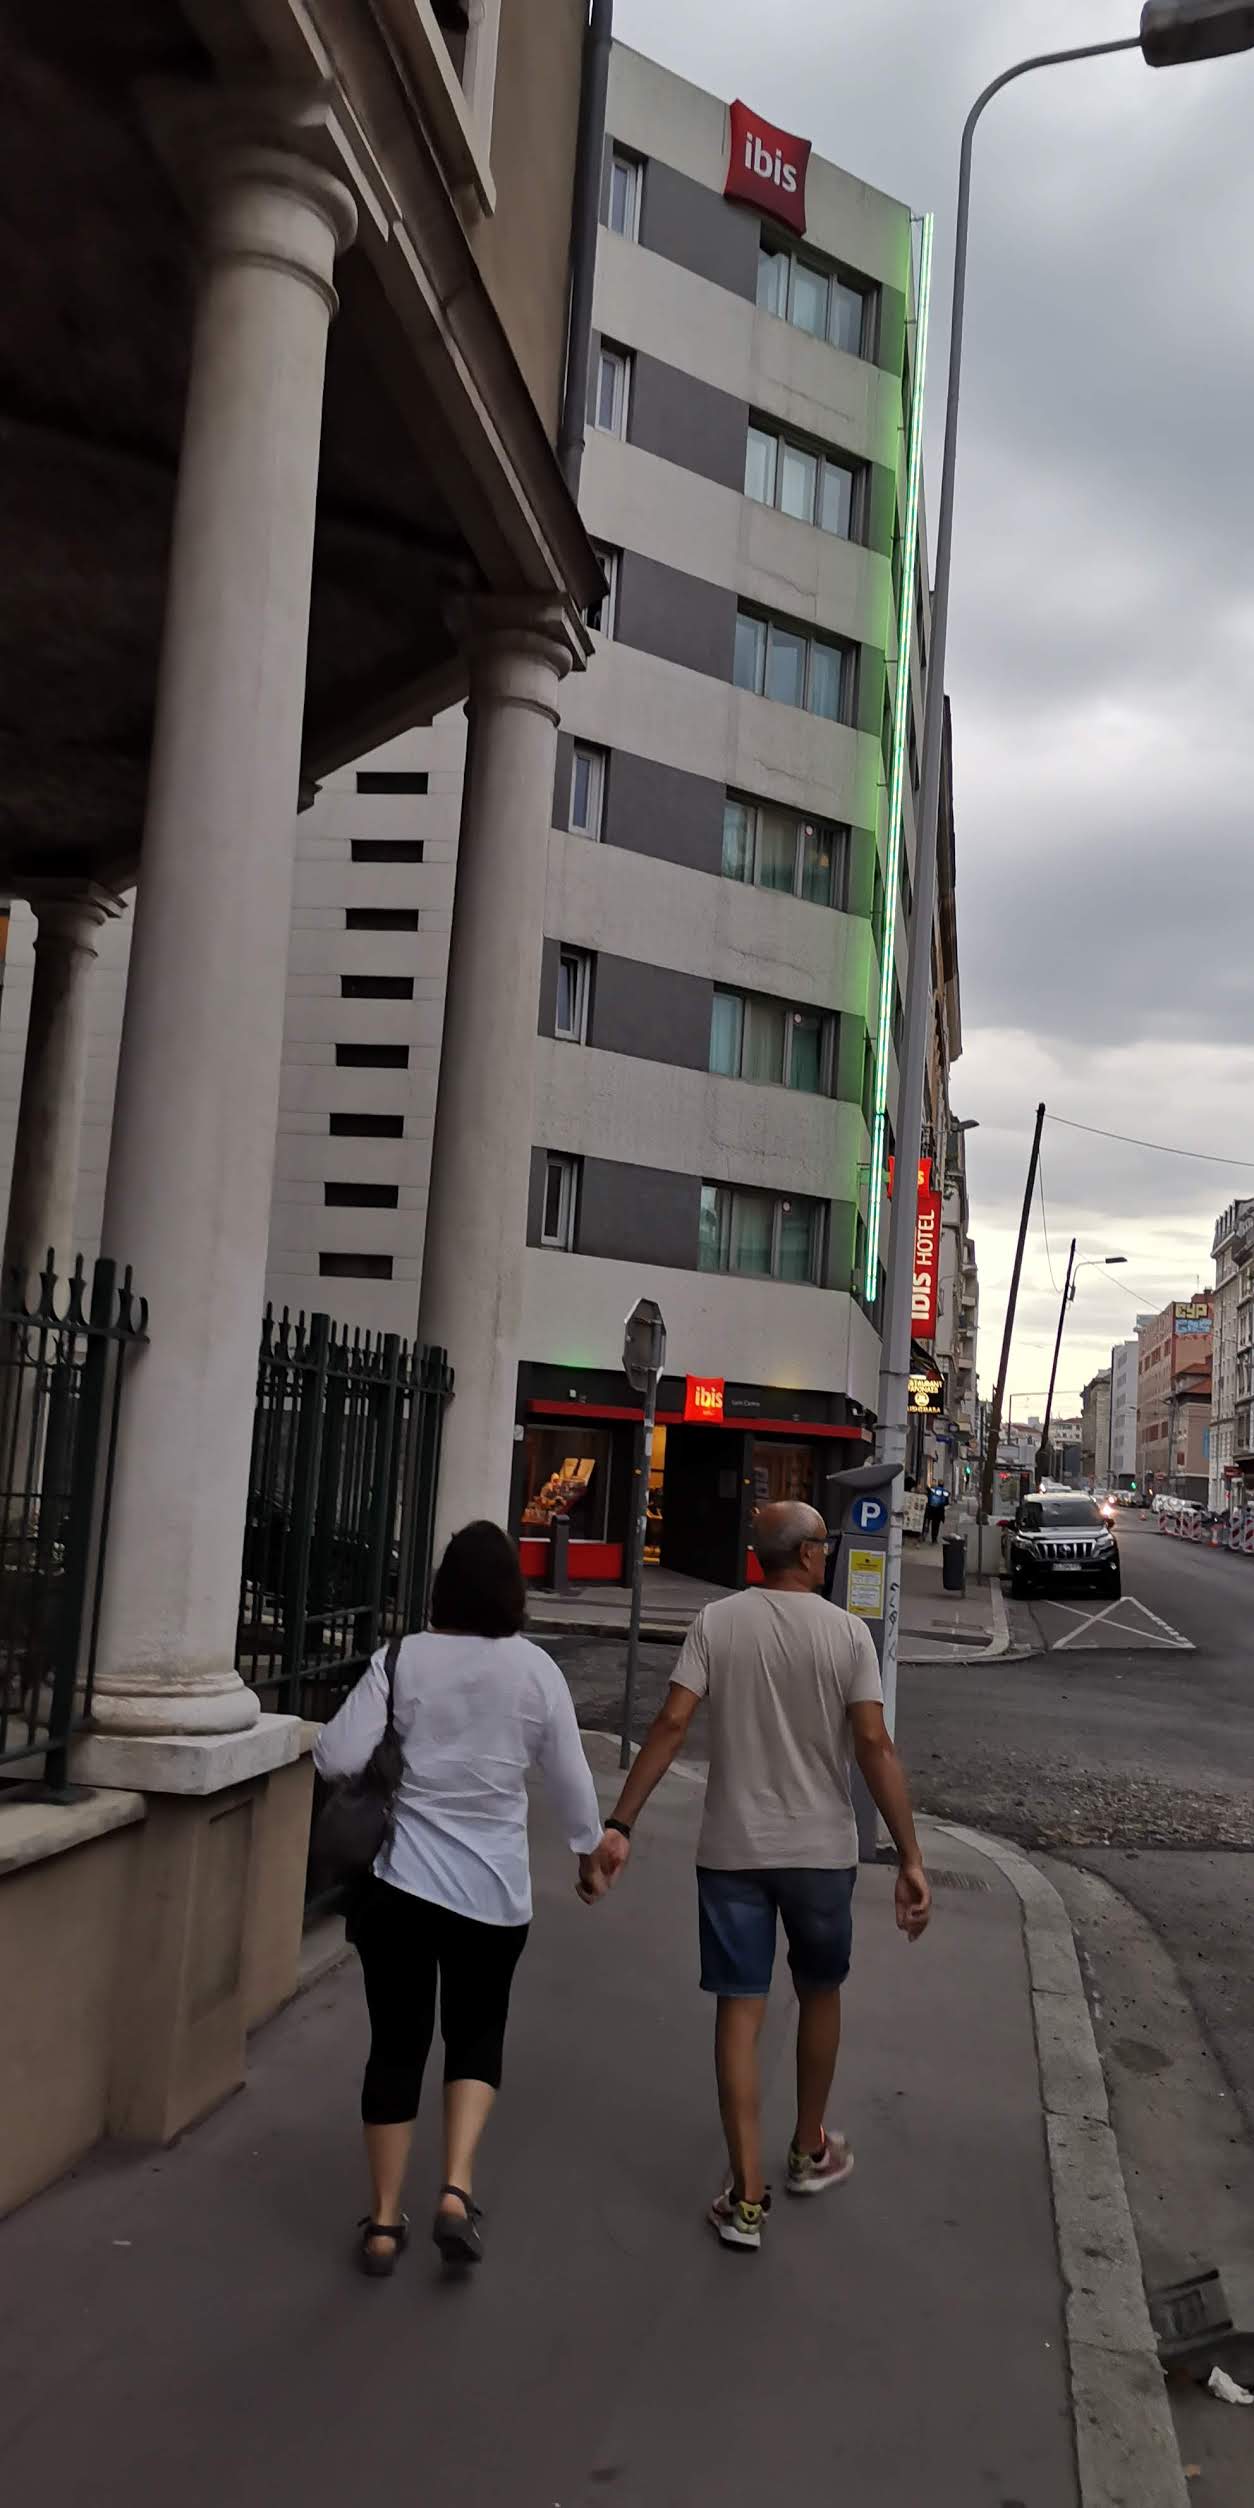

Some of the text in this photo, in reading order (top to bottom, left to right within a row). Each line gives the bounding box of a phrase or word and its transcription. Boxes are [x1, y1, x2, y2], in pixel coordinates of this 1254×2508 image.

[744, 131, 797, 193] ibis
[916, 1209, 935, 1266] HOTEL
[695, 1385, 723, 1409] ibis
[861, 1502, 881, 1528] P
